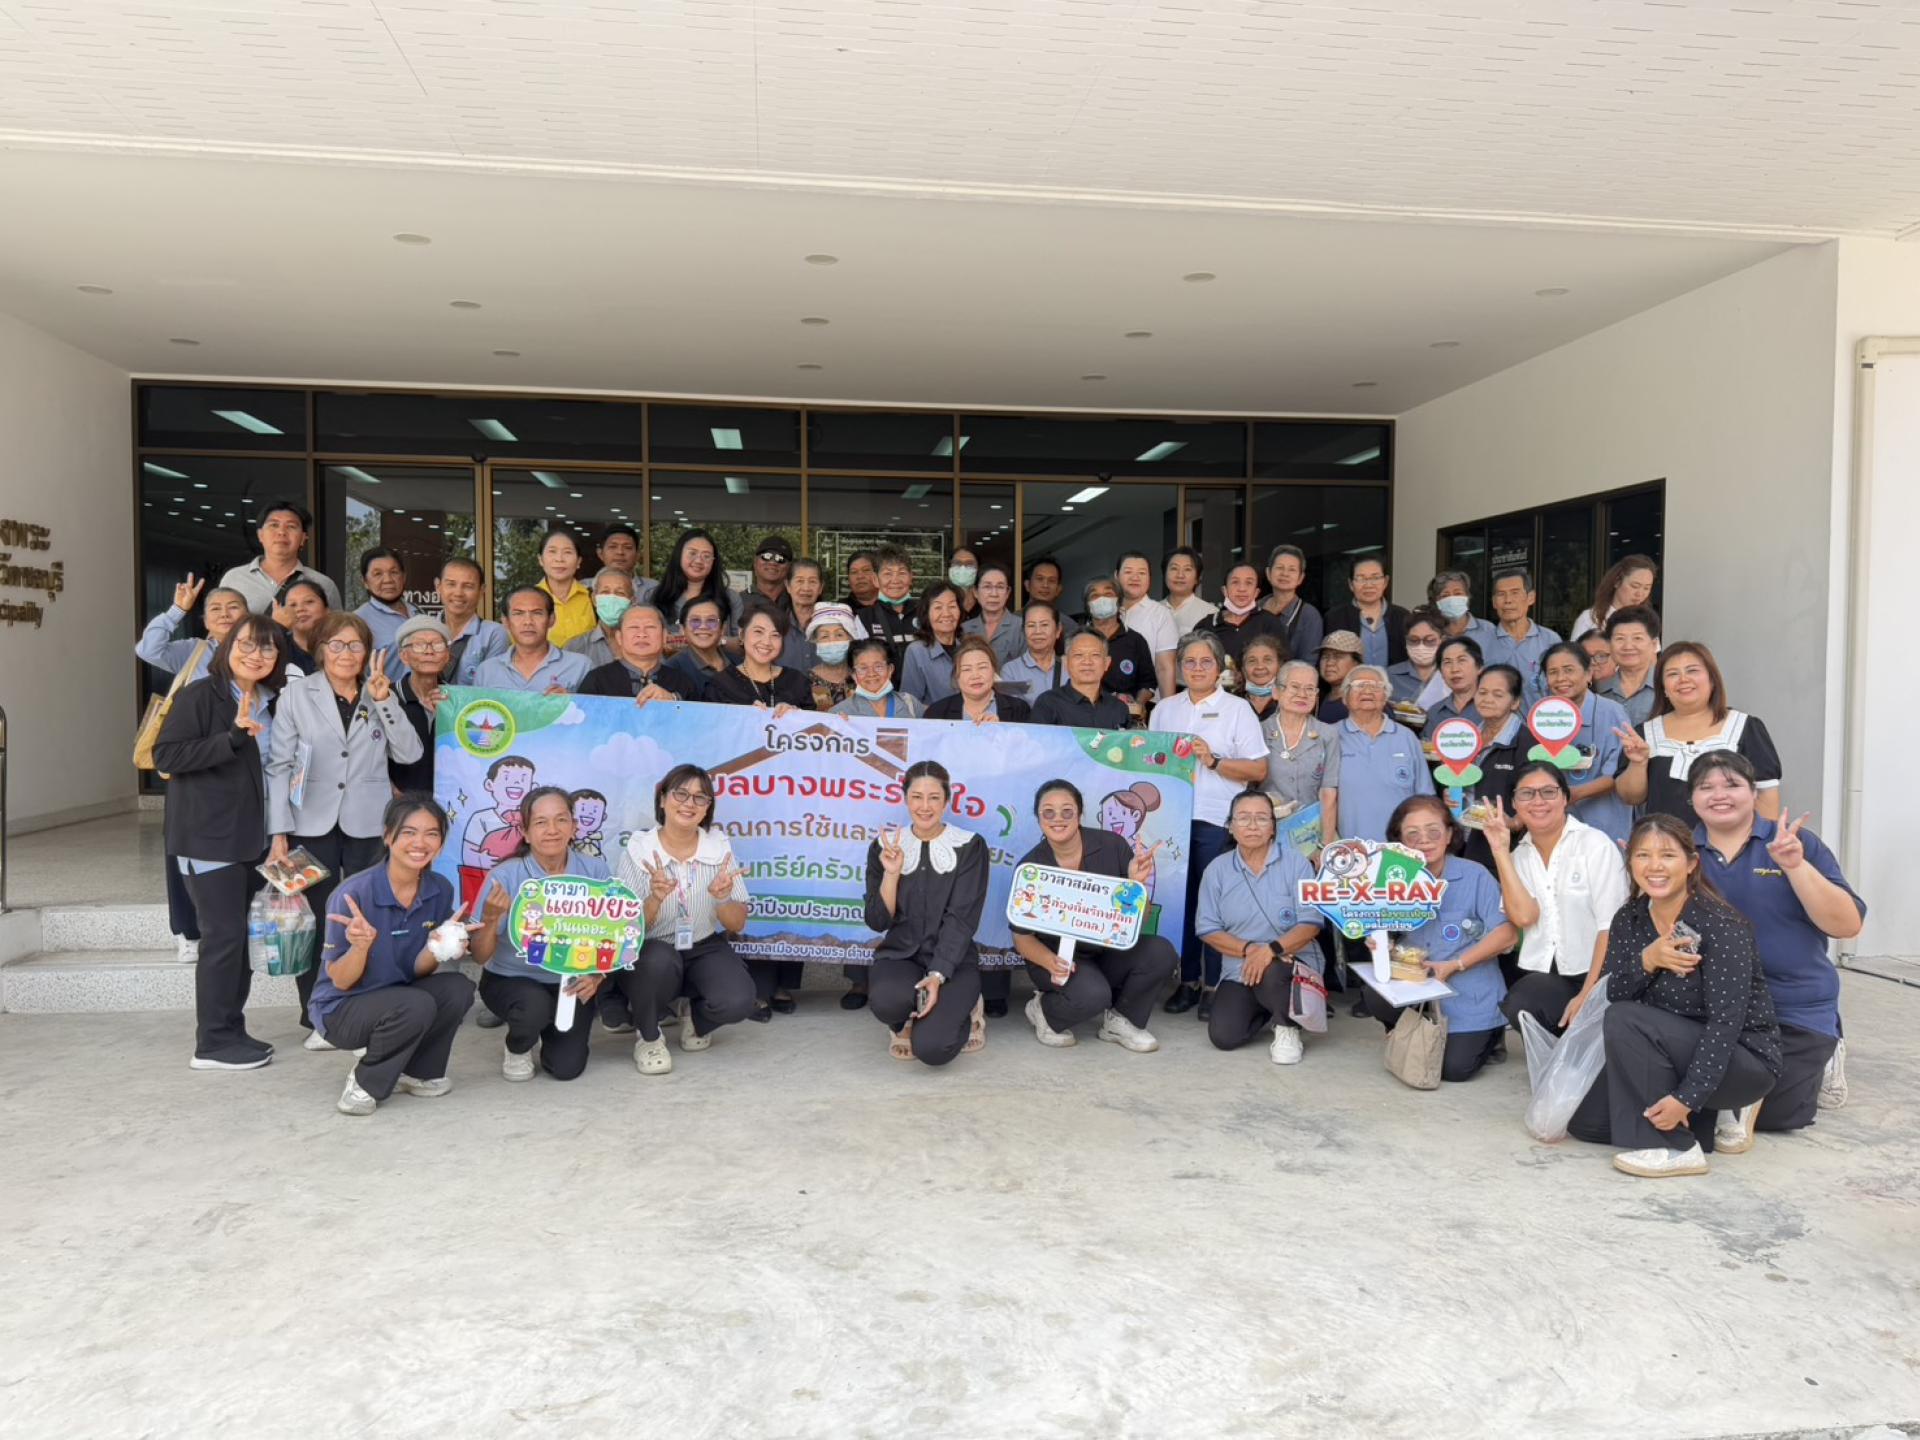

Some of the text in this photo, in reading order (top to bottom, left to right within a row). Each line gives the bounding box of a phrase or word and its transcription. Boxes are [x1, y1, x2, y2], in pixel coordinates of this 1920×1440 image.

[765, 724, 870, 754] โครงการ
[544, 881, 587, 896] เรามา
[1301, 881, 1446, 902] RE-X-RAY
[545, 897, 640, 918] แยกขยะ
